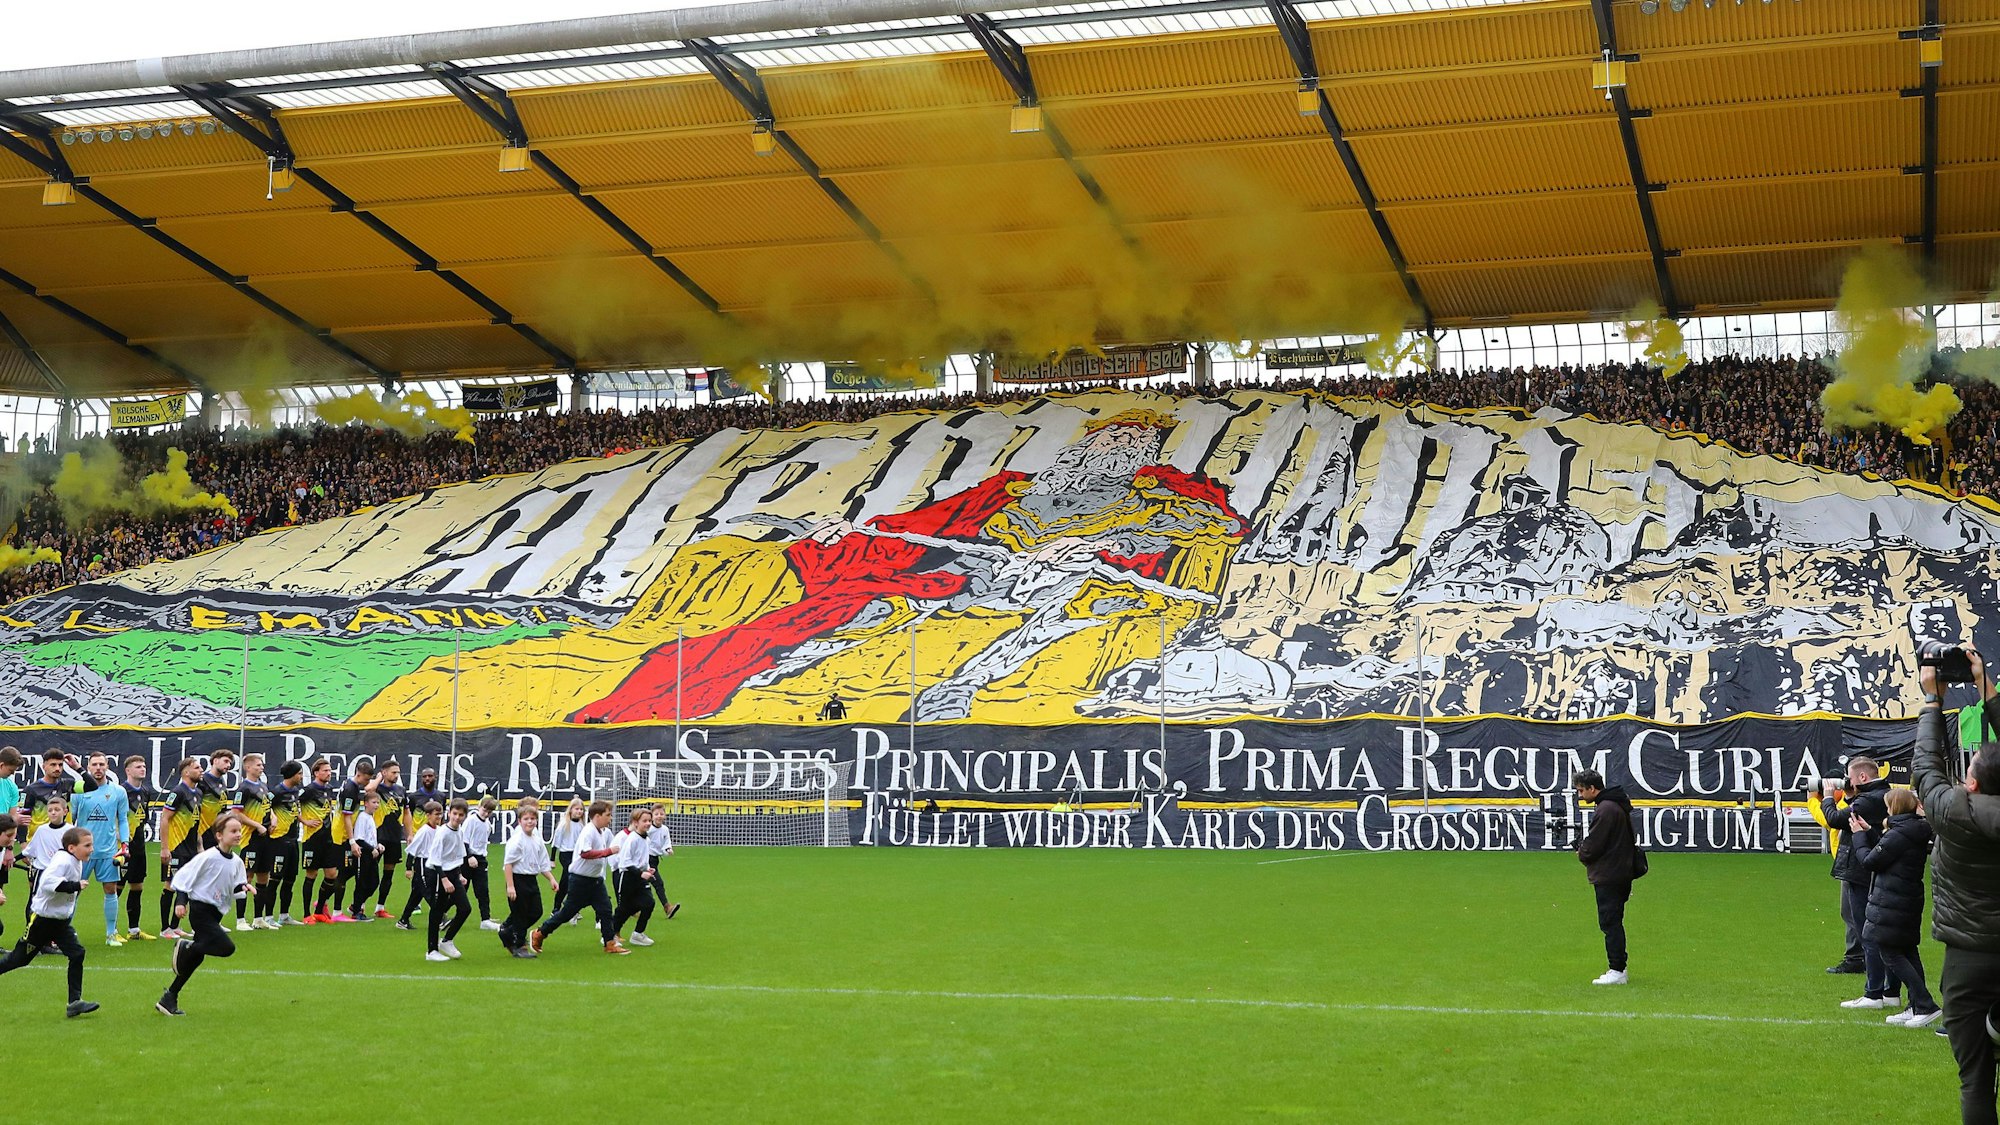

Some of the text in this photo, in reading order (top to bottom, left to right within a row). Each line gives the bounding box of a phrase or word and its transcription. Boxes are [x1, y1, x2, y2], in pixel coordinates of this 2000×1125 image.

[1103, 352, 1141, 374] SEIT
[1146, 348, 1182, 372] 1900
[116, 404, 149, 415] KÖLSCHE
[117, 413, 160, 424] ALEMANNEN
[503, 733, 664, 791] REGNI
[677, 728, 838, 791] SEDES
[850, 728, 1188, 798] PRINCIPALIS,
[1203, 728, 1385, 792] PRIMA
[1395, 726, 1612, 792] REGUM
[1628, 729, 1824, 795] CURIA
[1891, 765, 1908, 773] CLUB
[859, 791, 993, 848] FÜLLET
[1002, 810, 1133, 849] WIEDER
[1141, 792, 1265, 850] KARLS
[1275, 810, 1344, 851] DES
[1356, 794, 1528, 851] GROSSEN
[1540, 792, 1764, 851] HEIGTUM
